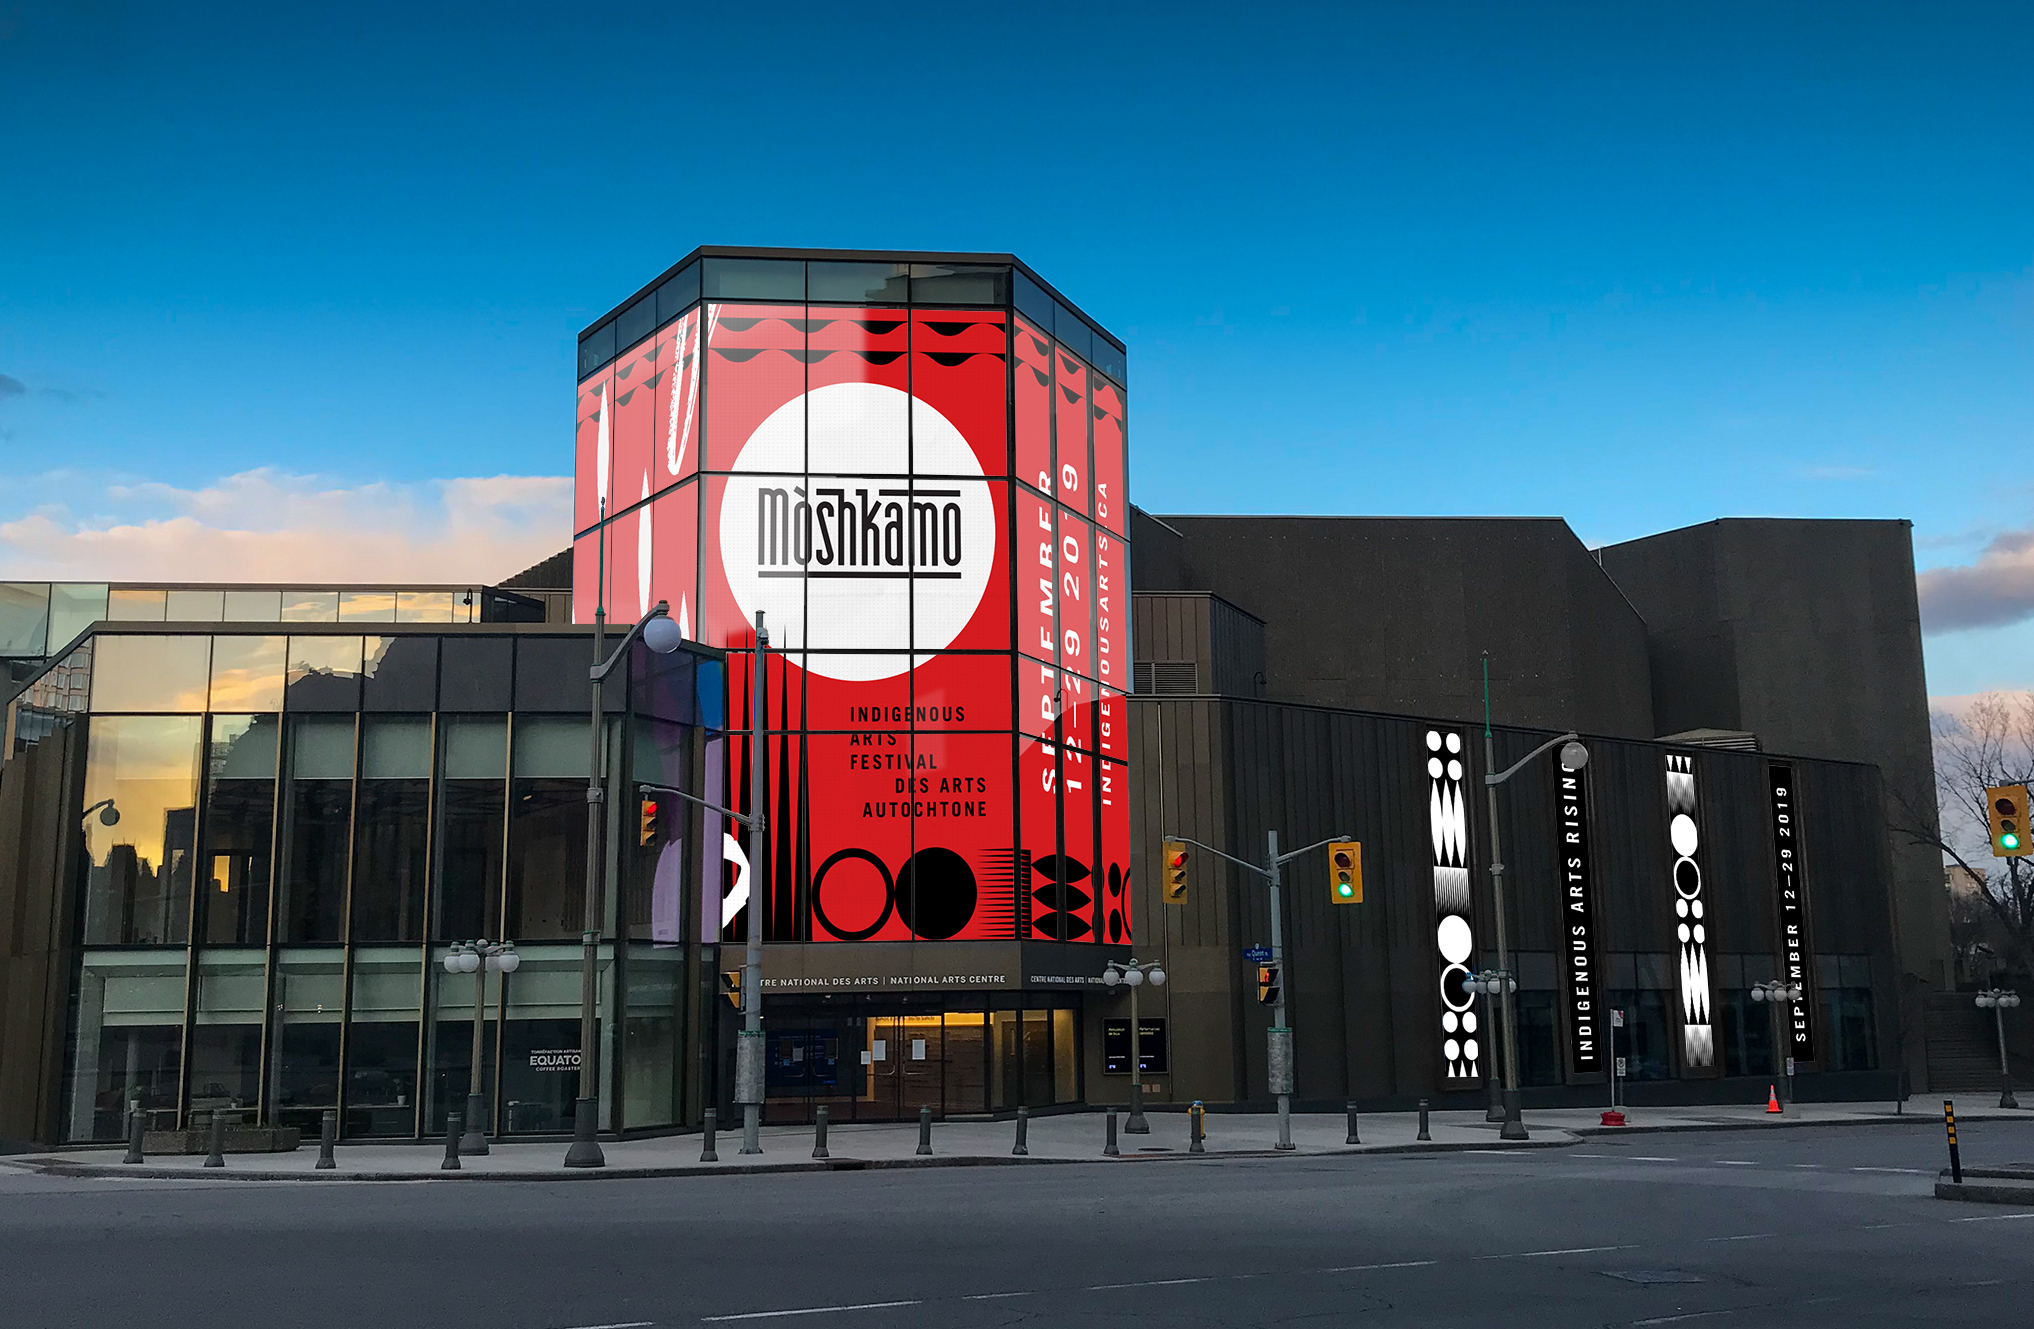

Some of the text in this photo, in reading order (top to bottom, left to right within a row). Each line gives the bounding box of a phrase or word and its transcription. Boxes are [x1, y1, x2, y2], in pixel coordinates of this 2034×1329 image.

[1038, 470, 1056, 794] SEPTEMBER
[850, 706, 965, 722] INDIGENOUS
[850, 734, 897, 746] ARTS
[850, 754, 937, 770] FESTIVAL
[895, 777, 986, 794] DES ARTS
[862, 801, 987, 818] AUTOCHTONE
[1776, 787, 1790, 836] 2019
[1567, 857, 1585, 912] ARTS
[780, 978, 830, 987] NATIONAL
[832, 977, 851, 986] DES
[854, 977, 879, 985] ARTS
[890, 975, 939, 985] NATIONAL
[941, 975, 967, 984] ARTS
[968, 974, 1006, 984] CENTRE
[1030, 975, 1046, 983] CENTRE
[1047, 976, 1065, 984] NATIONAL
[1066, 976, 1074, 984] DES
[1572, 925, 1594, 1060] INDIGENOUS
[529, 1055, 581, 1066] EQUATO
